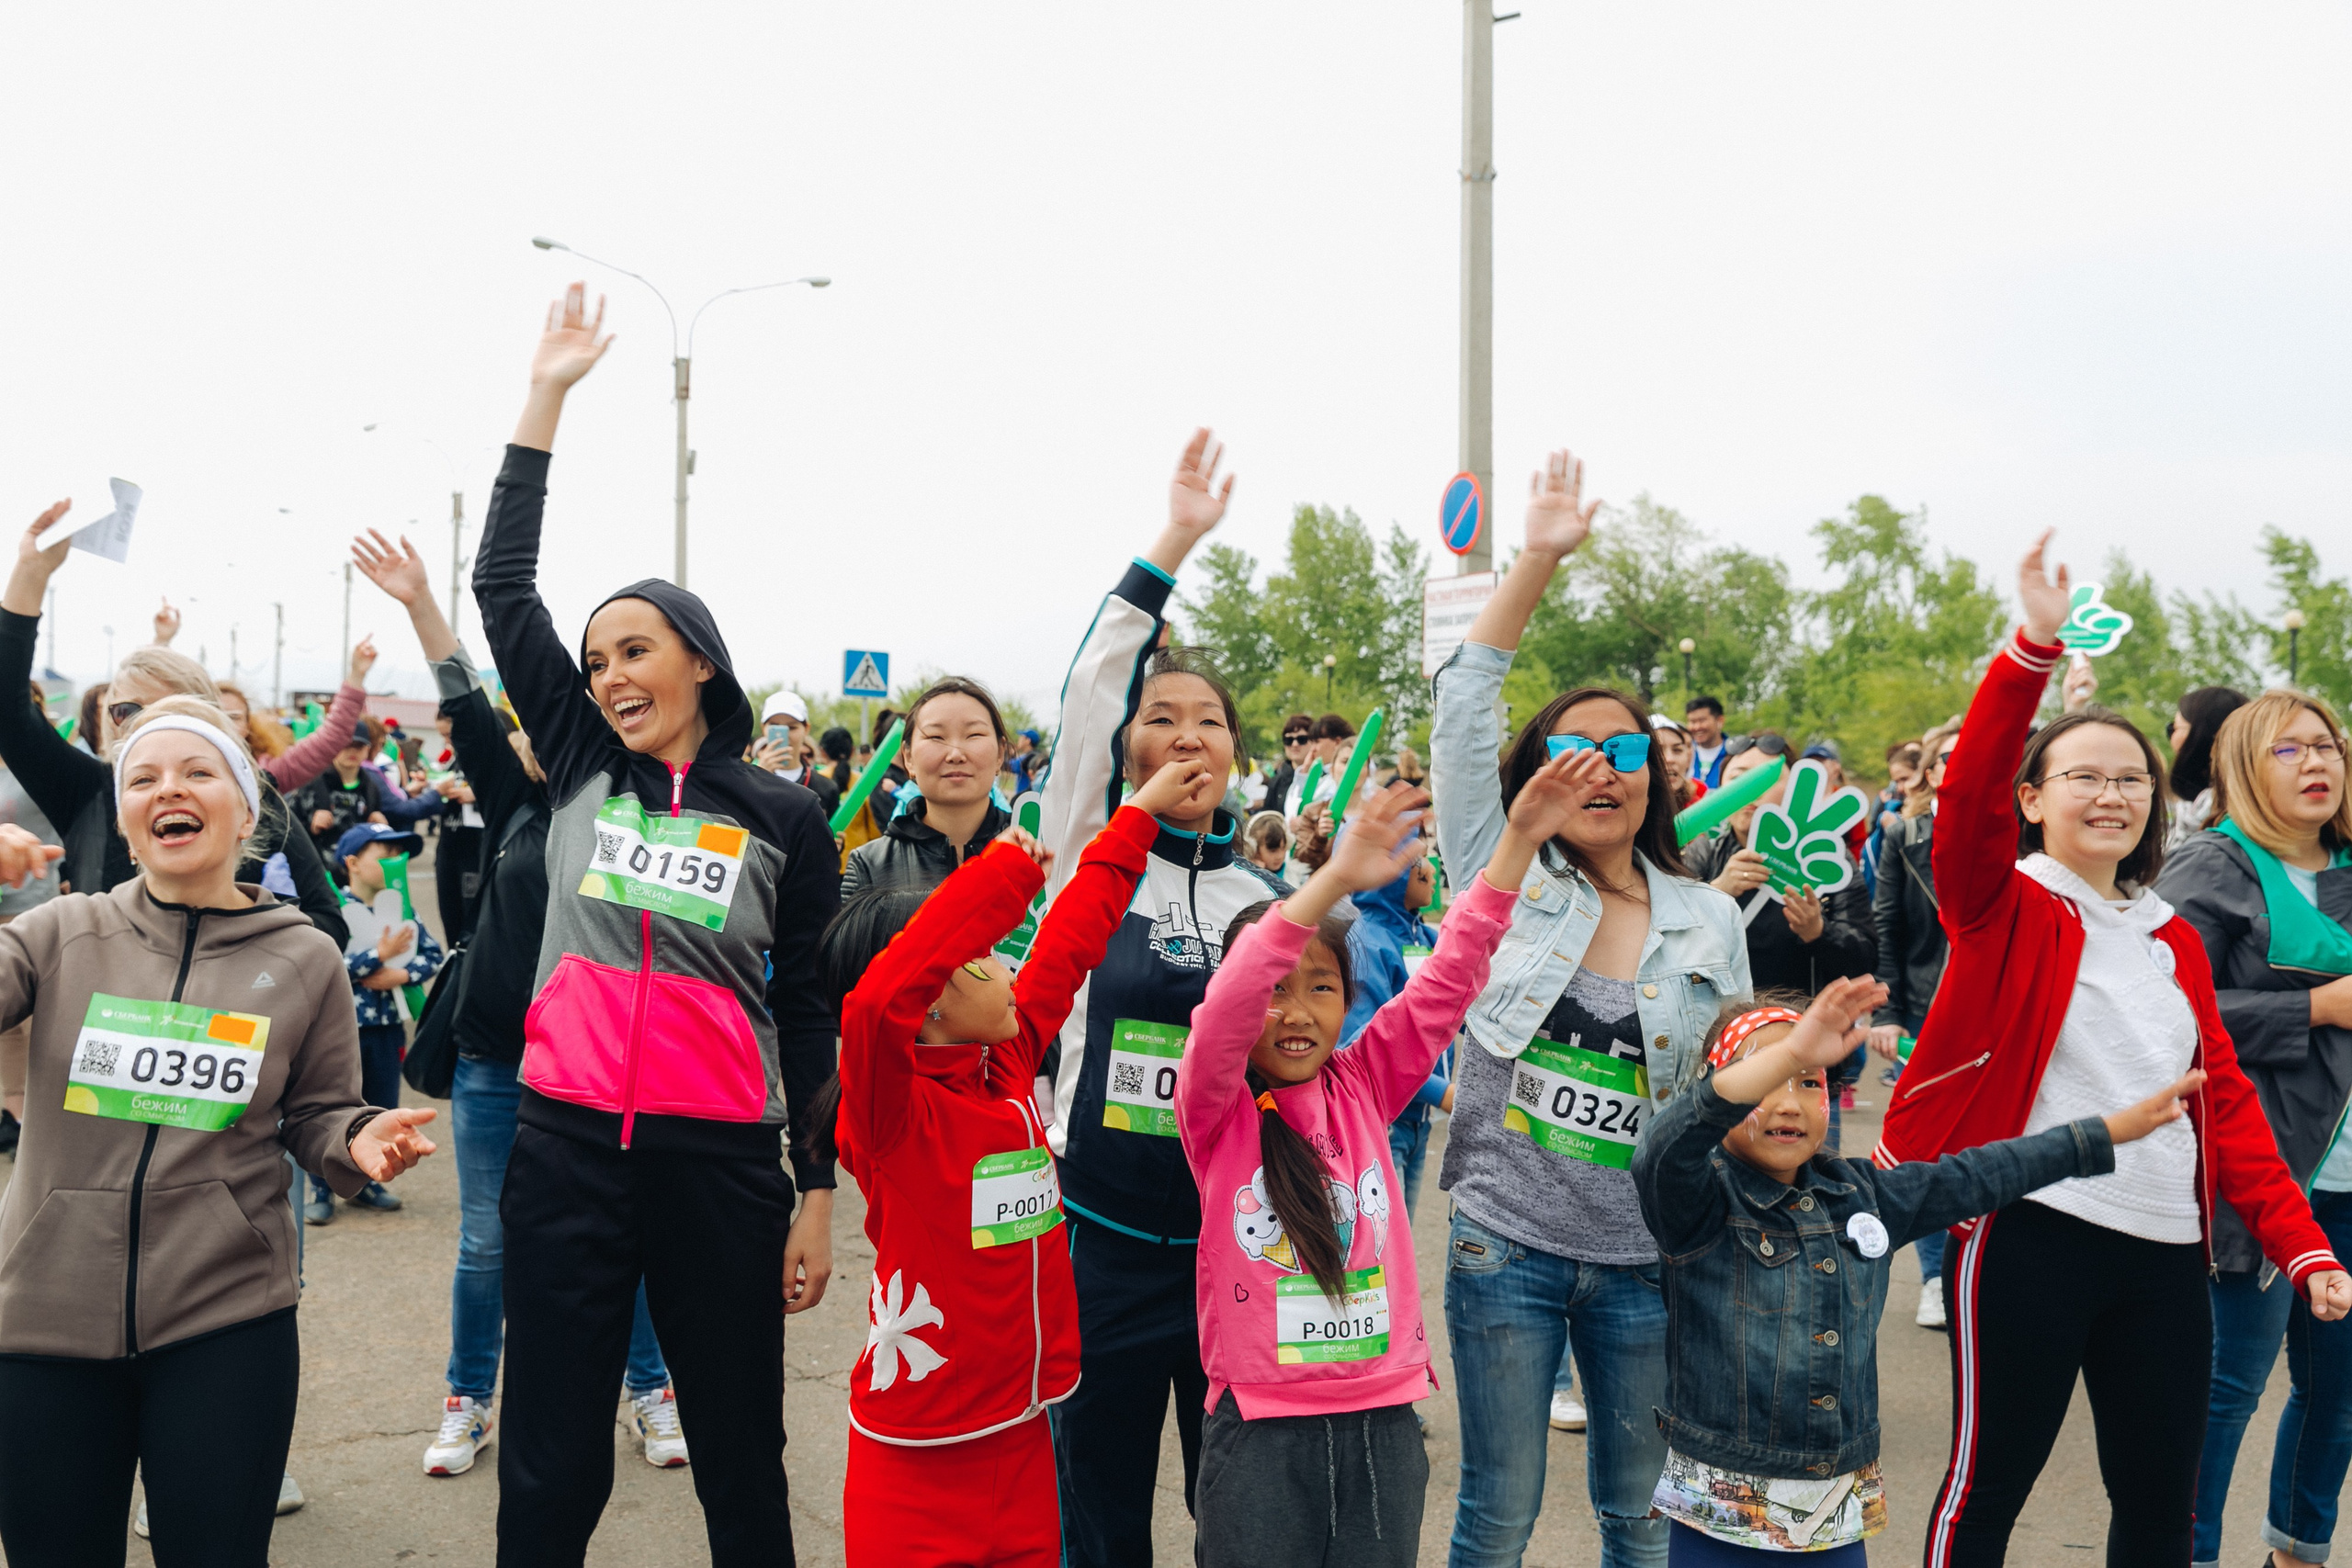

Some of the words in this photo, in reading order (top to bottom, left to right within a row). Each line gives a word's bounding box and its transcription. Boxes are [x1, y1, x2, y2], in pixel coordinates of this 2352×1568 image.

[628, 844, 726, 894] 0159
[626, 881, 673, 903] бежим
[1134, 1033, 1166, 1043] СБЕРБАНК
[130, 1046, 248, 1093] 0396
[1155, 1066, 1178, 1100] 0
[131, 1095, 187, 1114] бежим
[1551, 1085, 1642, 1138] 0324
[1158, 1112, 1177, 1125] бе
[1549, 1129, 1596, 1153] бежим
[997, 1189, 1053, 1222] P-0017
[1013, 1218, 1044, 1234] бежим
[1303, 1316, 1374, 1340] P-0018
[1323, 1343, 1360, 1354] бежим
